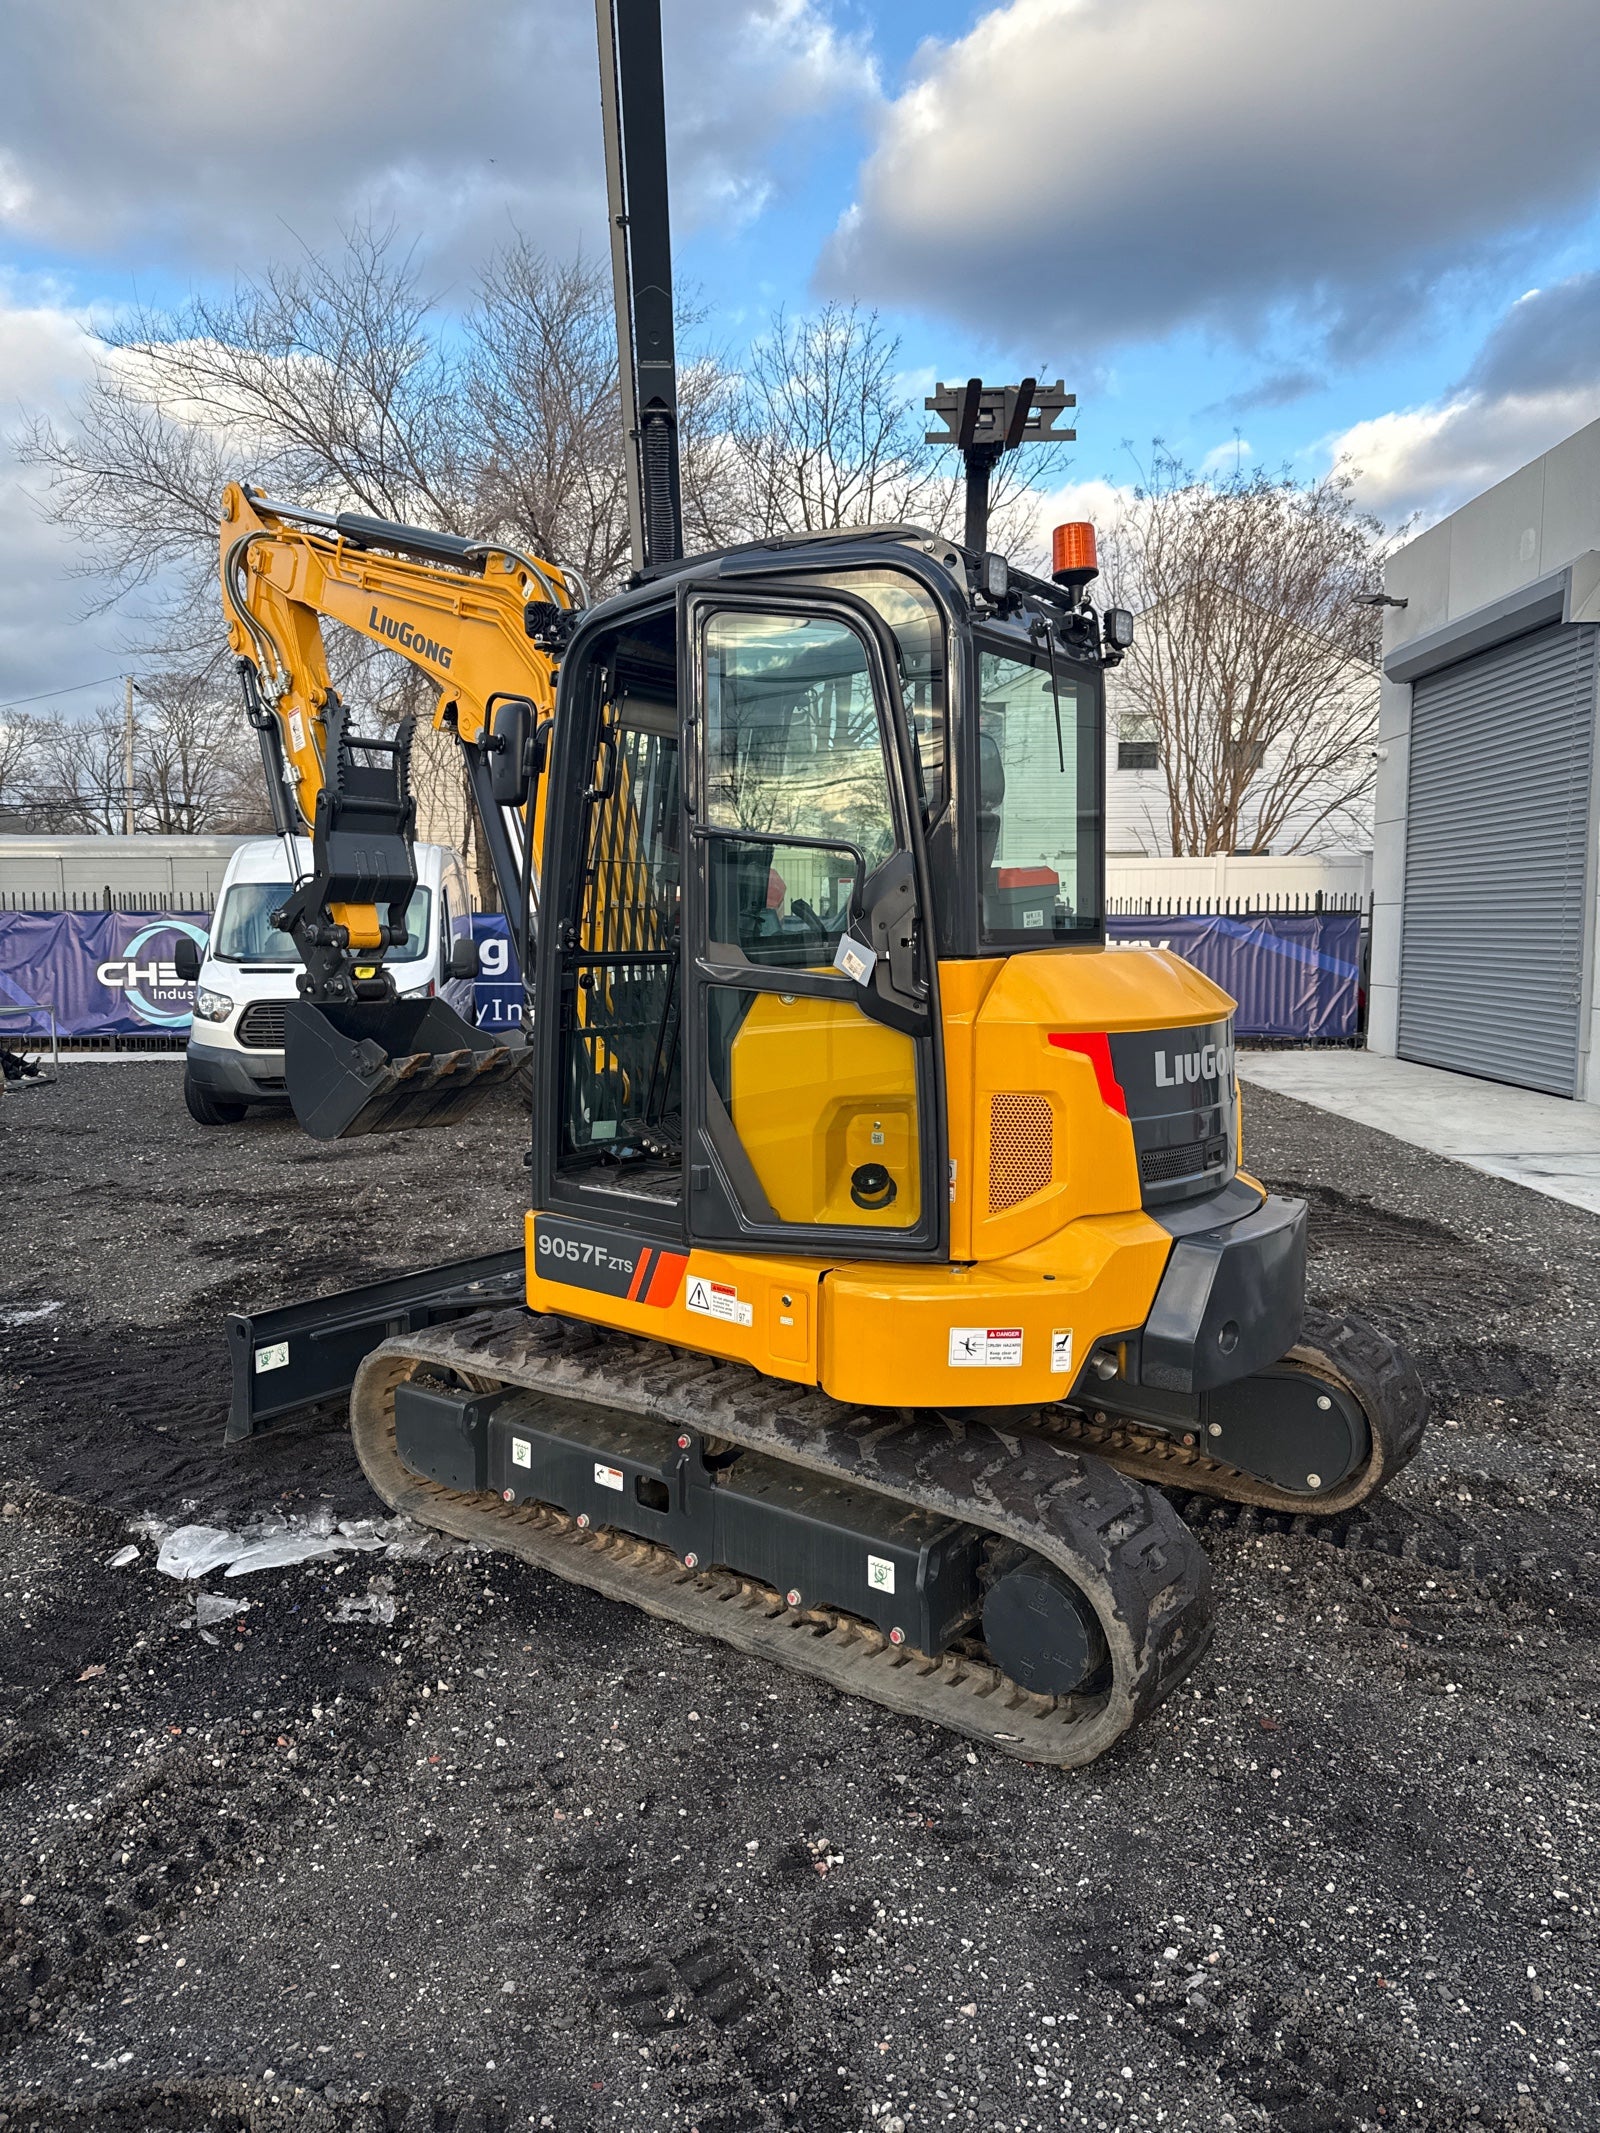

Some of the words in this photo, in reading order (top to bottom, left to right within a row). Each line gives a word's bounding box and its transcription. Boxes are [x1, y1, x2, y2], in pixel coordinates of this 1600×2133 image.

[97, 962, 196, 987] CHE
[153, 988, 195, 1000] Indus
[538, 1234, 608, 1266] 9057F
[608, 1256, 633, 1273] ZTS
